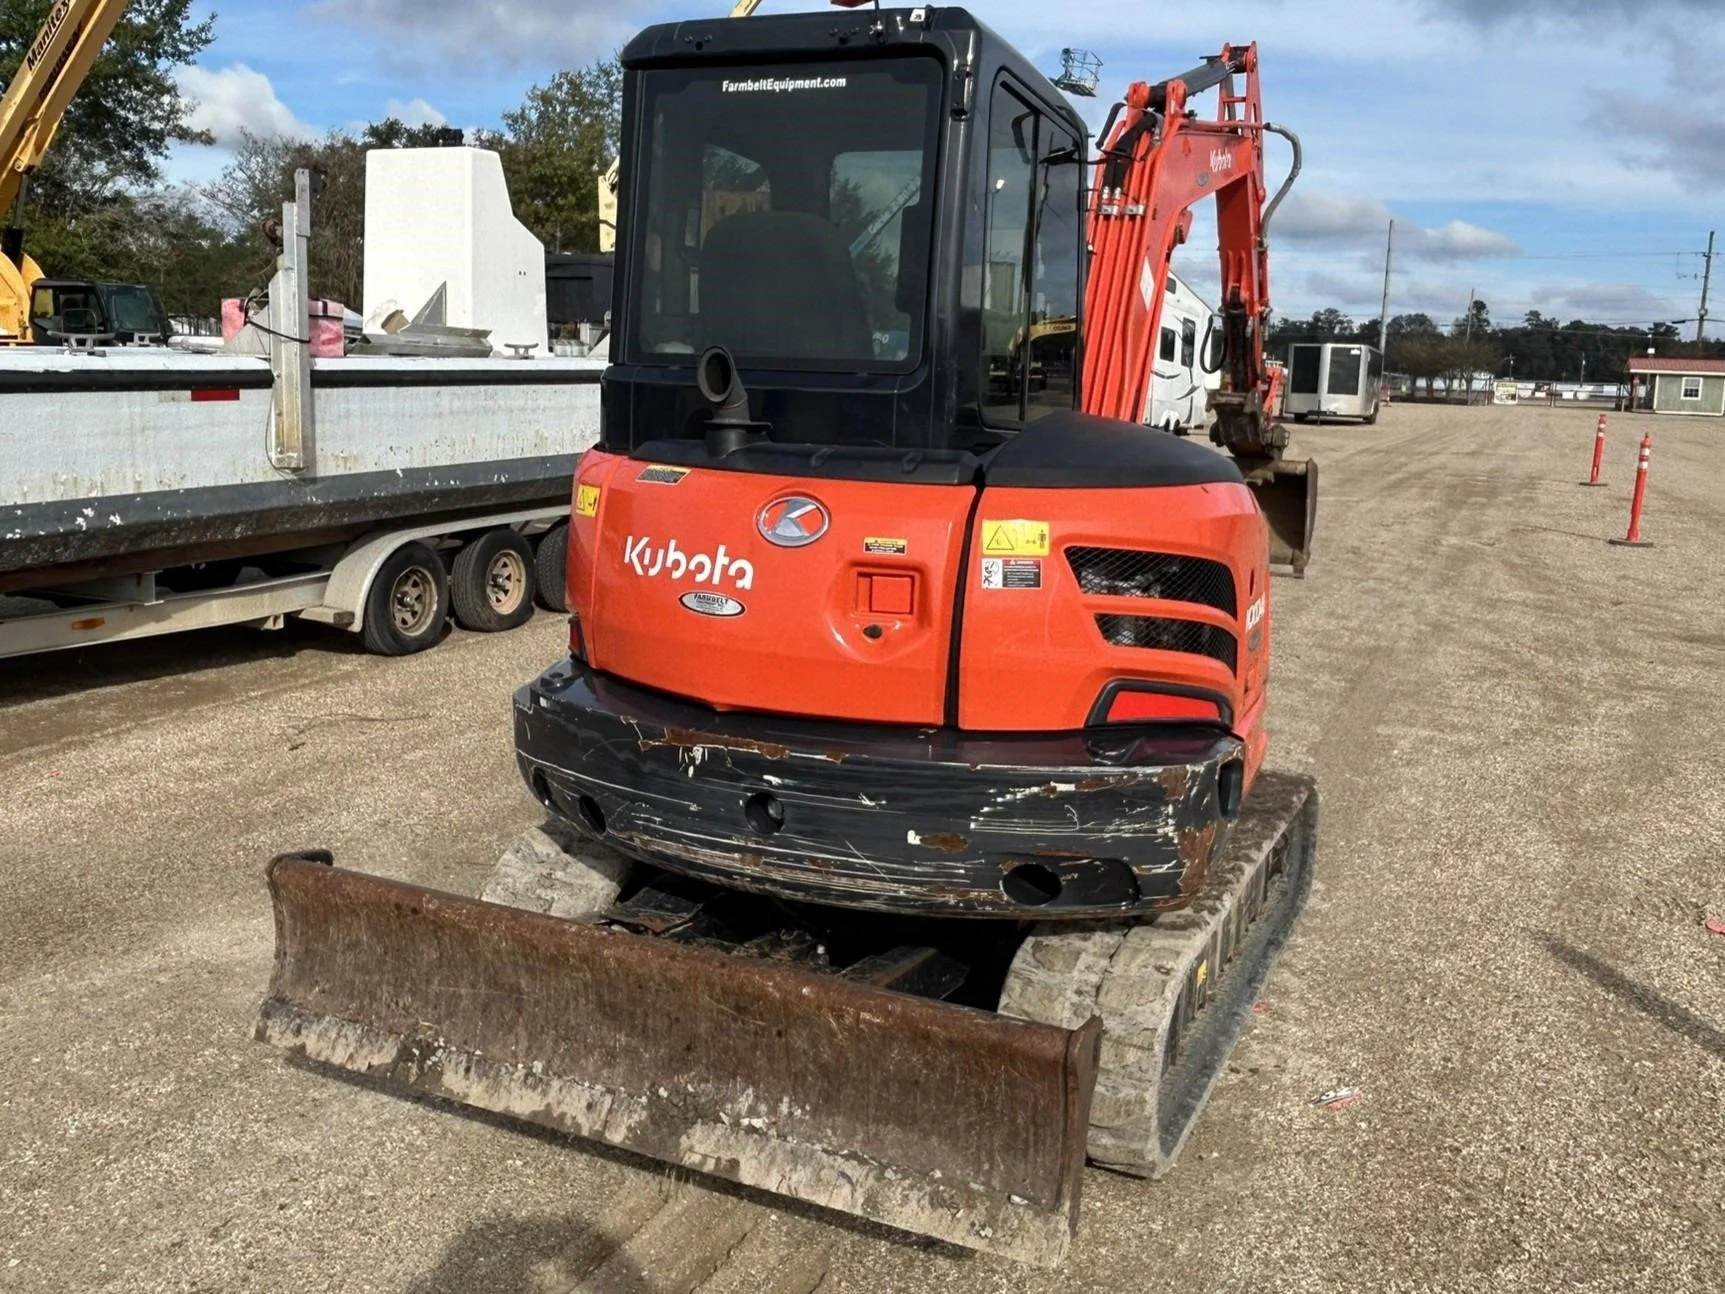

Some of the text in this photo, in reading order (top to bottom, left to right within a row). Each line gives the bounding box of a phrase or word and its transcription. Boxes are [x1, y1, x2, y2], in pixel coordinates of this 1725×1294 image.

[26, 0, 69, 71] Manitex
[722, 77, 846, 93] FarmbeltEquipment.com
[624, 535, 754, 590] Kubota
